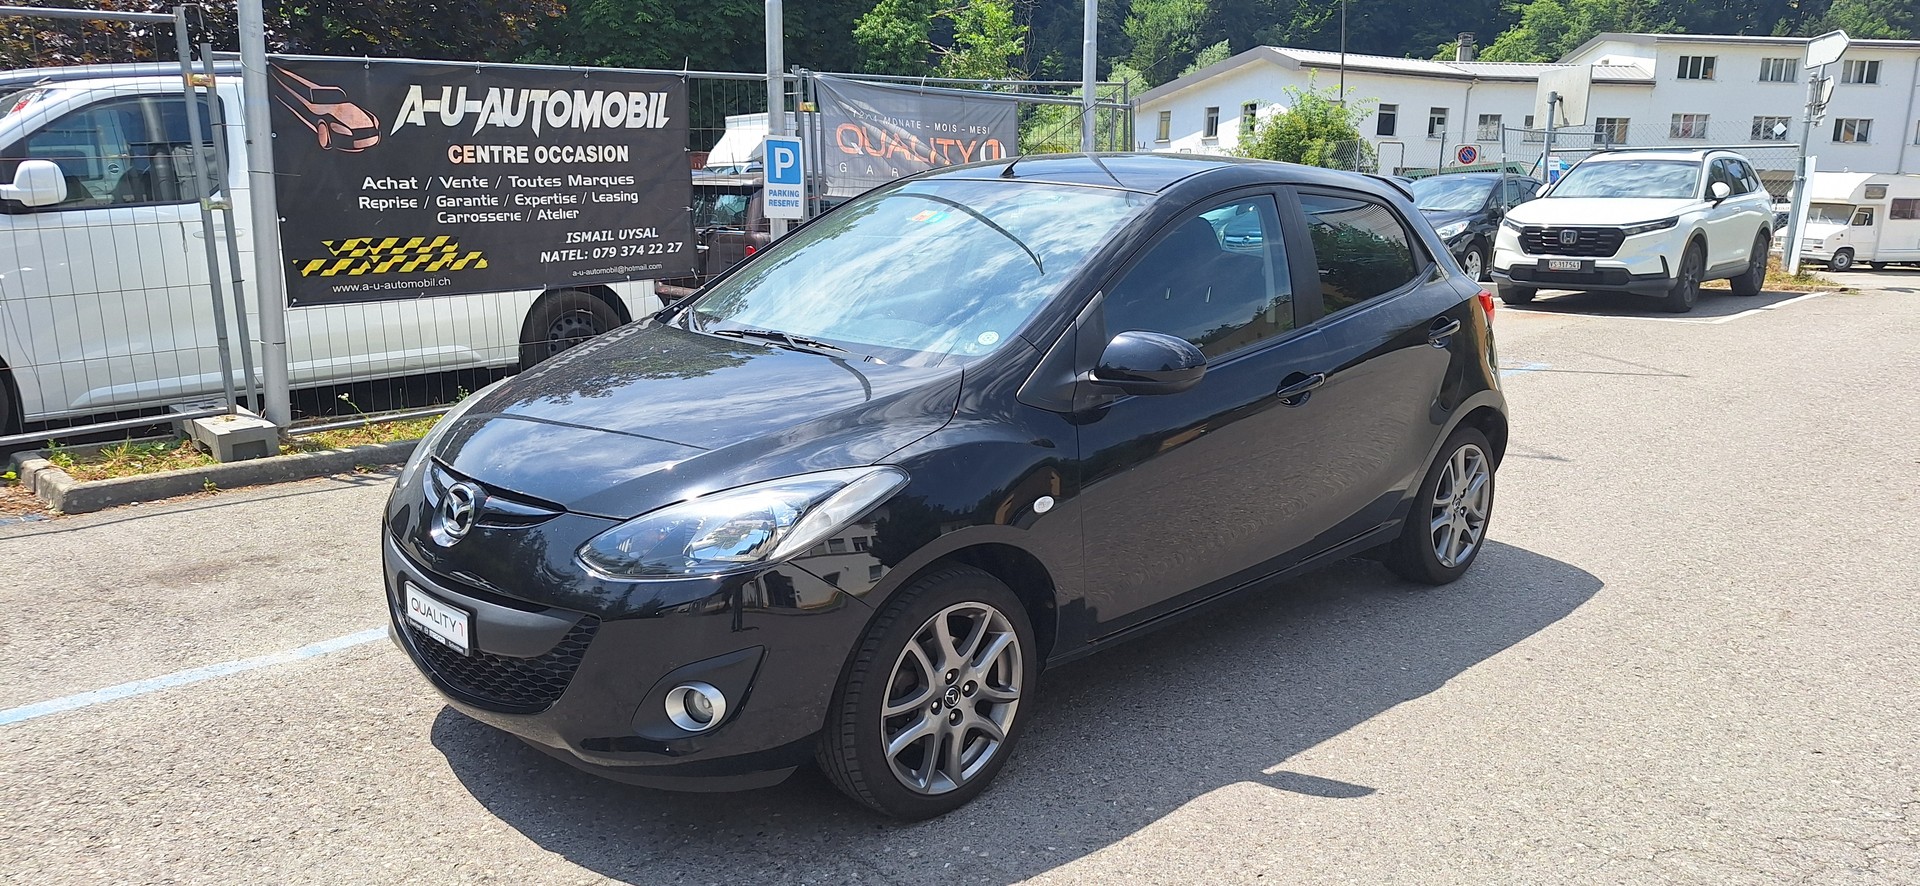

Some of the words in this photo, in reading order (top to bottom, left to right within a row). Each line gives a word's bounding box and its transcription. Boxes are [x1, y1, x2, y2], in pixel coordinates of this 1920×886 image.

[390, 85, 670, 138] A-U-AUTOMOBIL
[883, 116, 921, 129] MONATE
[934, 122, 957, 133] MOIS
[969, 125, 990, 135] MESI
[448, 145, 529, 164] CENTRE
[534, 145, 629, 164] OCCASION
[774, 147, 795, 179] P
[362, 176, 418, 190] Achat
[439, 175, 489, 189] Vente
[508, 175, 562, 188] Toutes
[568, 174, 635, 188] Marques
[358, 196, 418, 211] Reprise
[436, 194, 499, 208] Garantie
[514, 192, 577, 208] Expertise
[591, 190, 639, 204] Leasing
[768, 189, 800, 198] PARKING
[768, 199, 800, 208] RESERVE
[437, 211, 522, 224] Carrosserie
[537, 208, 580, 221] Atelier
[566, 230, 615, 244] ISMAIL
[618, 227, 659, 240] UYSAL
[540, 249, 589, 263] NATEL:
[592, 246, 617, 259] 079
[620, 244, 645, 257] 374
[647, 242, 663, 255] 22
[667, 241, 683, 253] 27
[572, 262, 663, 277] a-u-automobil@hotmail.com
[332, 277, 451, 293] www.a-u-automobil.ch
